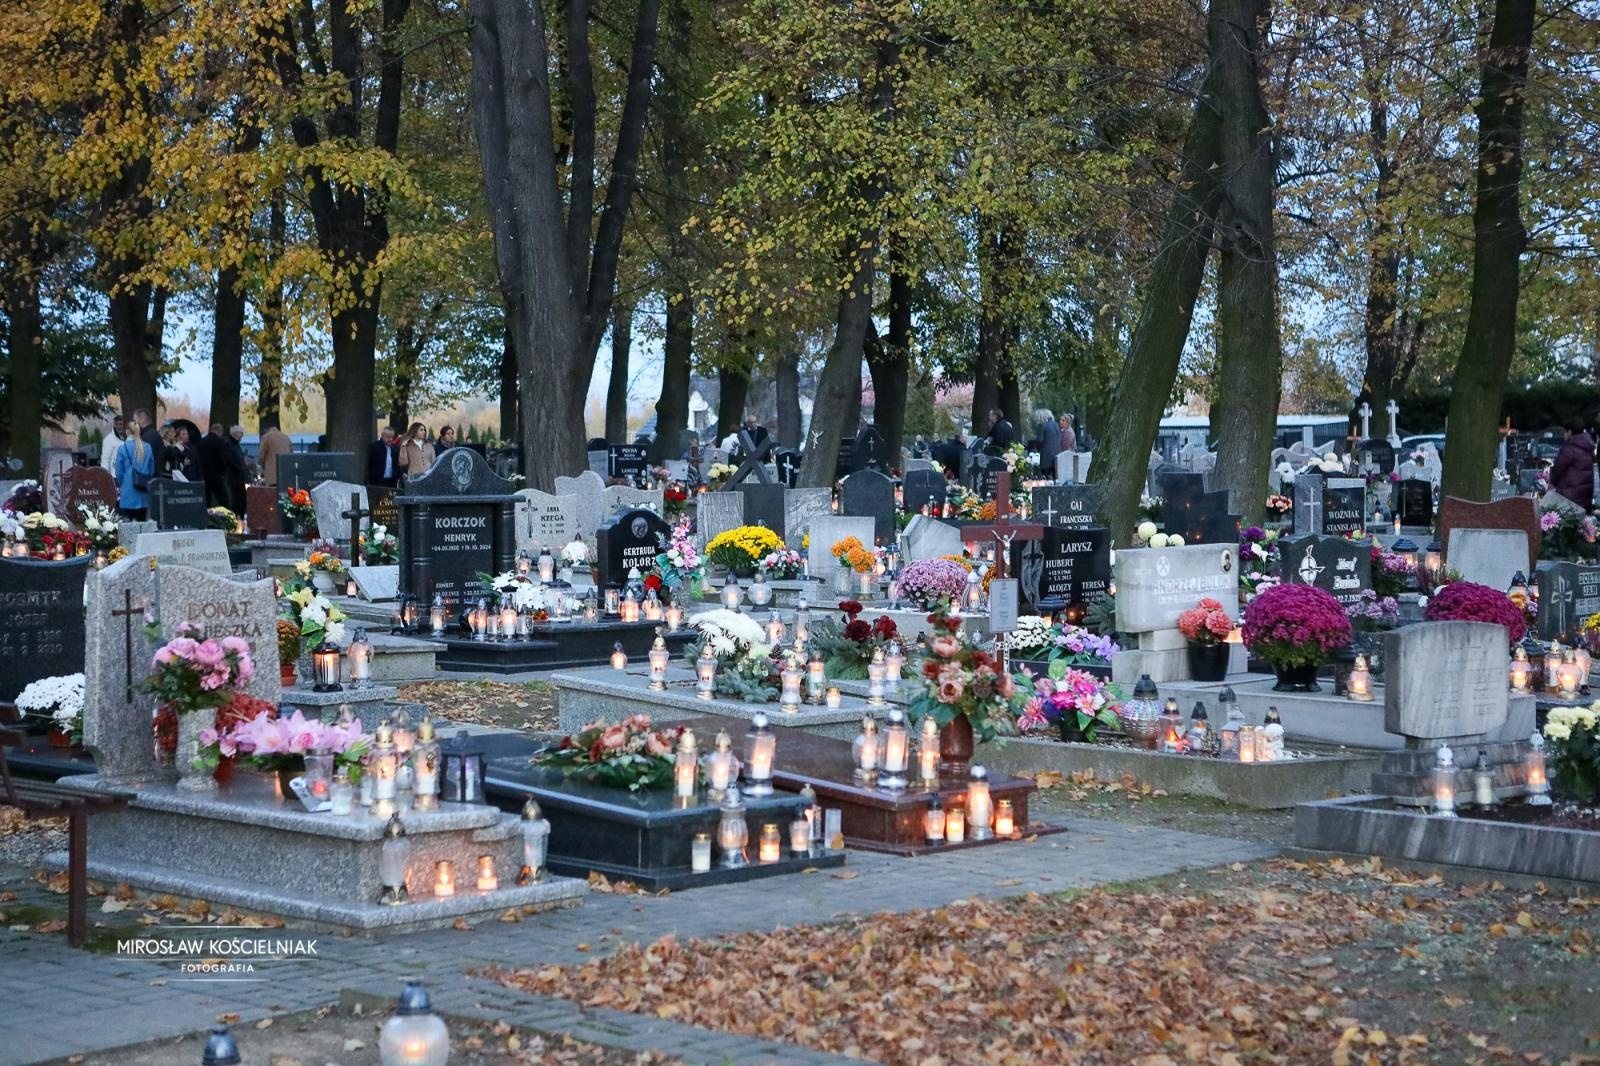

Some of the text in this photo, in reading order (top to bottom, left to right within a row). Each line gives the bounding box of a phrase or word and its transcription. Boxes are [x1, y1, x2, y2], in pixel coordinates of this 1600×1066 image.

[78, 488, 99, 496] Maria
[1070, 500, 1082, 511] GAJ
[435, 517, 486, 528] KORCZOK
[444, 533, 477, 542] HENRYK
[623, 546, 656, 556] GERTRUDA
[1061, 542, 1093, 553] LARYSZ
[622, 556, 656, 568] KOLORZ
[1046, 558, 1075, 568] HUBERT
[1048, 583, 1073, 592] ALOJZY
[1081, 580, 1106, 590] TERESA
[187, 601, 253, 620] DONAT
[204, 623, 263, 638] IESZKA
